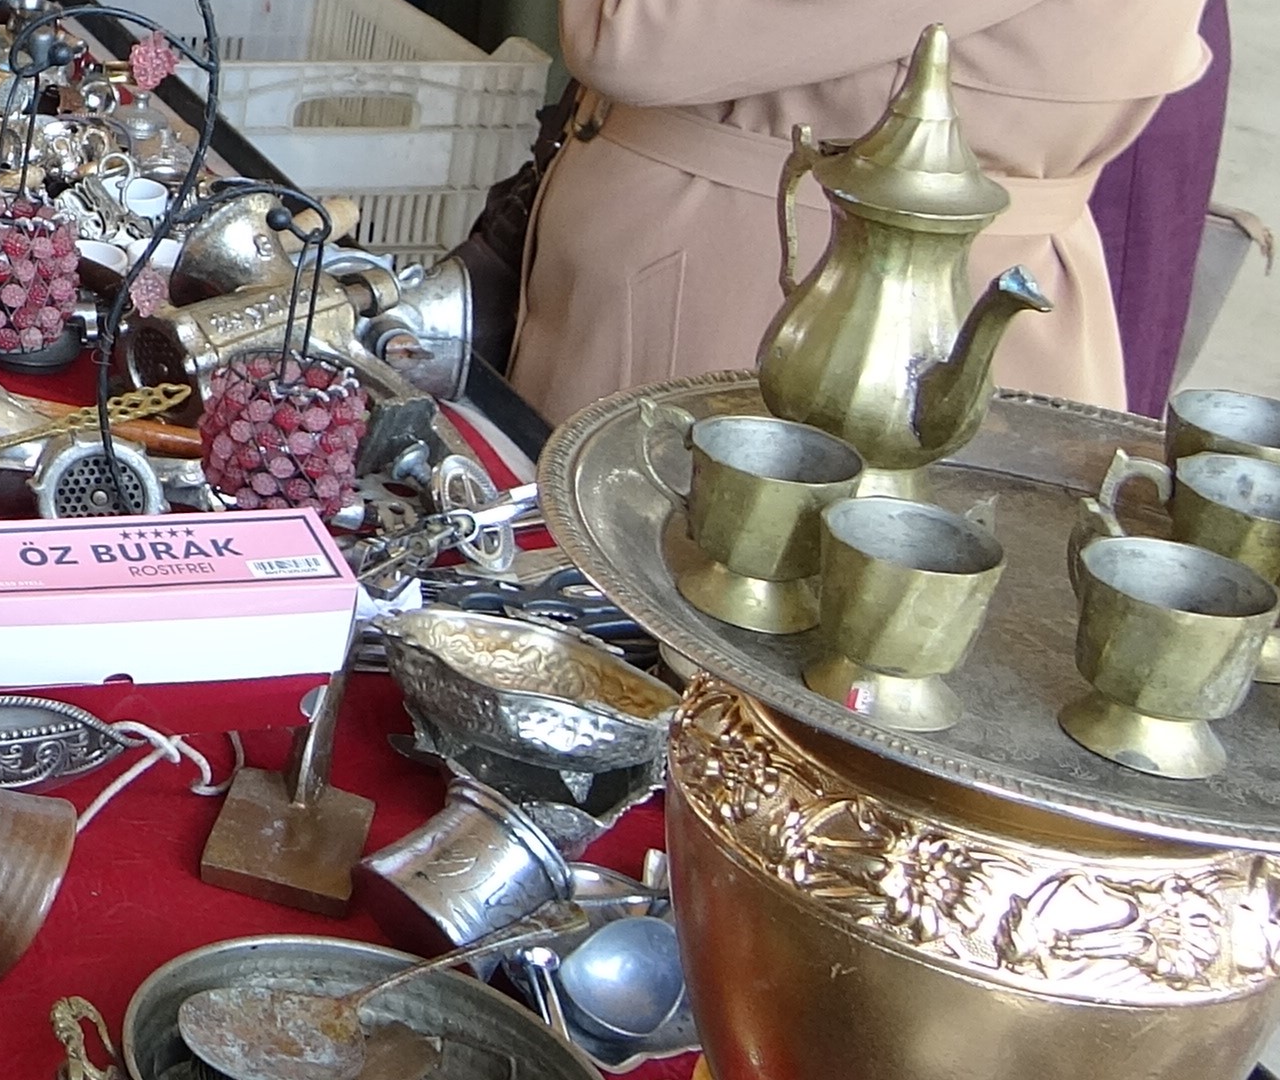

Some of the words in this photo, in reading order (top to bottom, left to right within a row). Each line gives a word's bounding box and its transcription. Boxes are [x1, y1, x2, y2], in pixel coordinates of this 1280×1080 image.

[19, 540, 79, 567] ÖZ
[90, 537, 244, 564] BURAK
[127, 562, 216, 578] ROSTFREI
